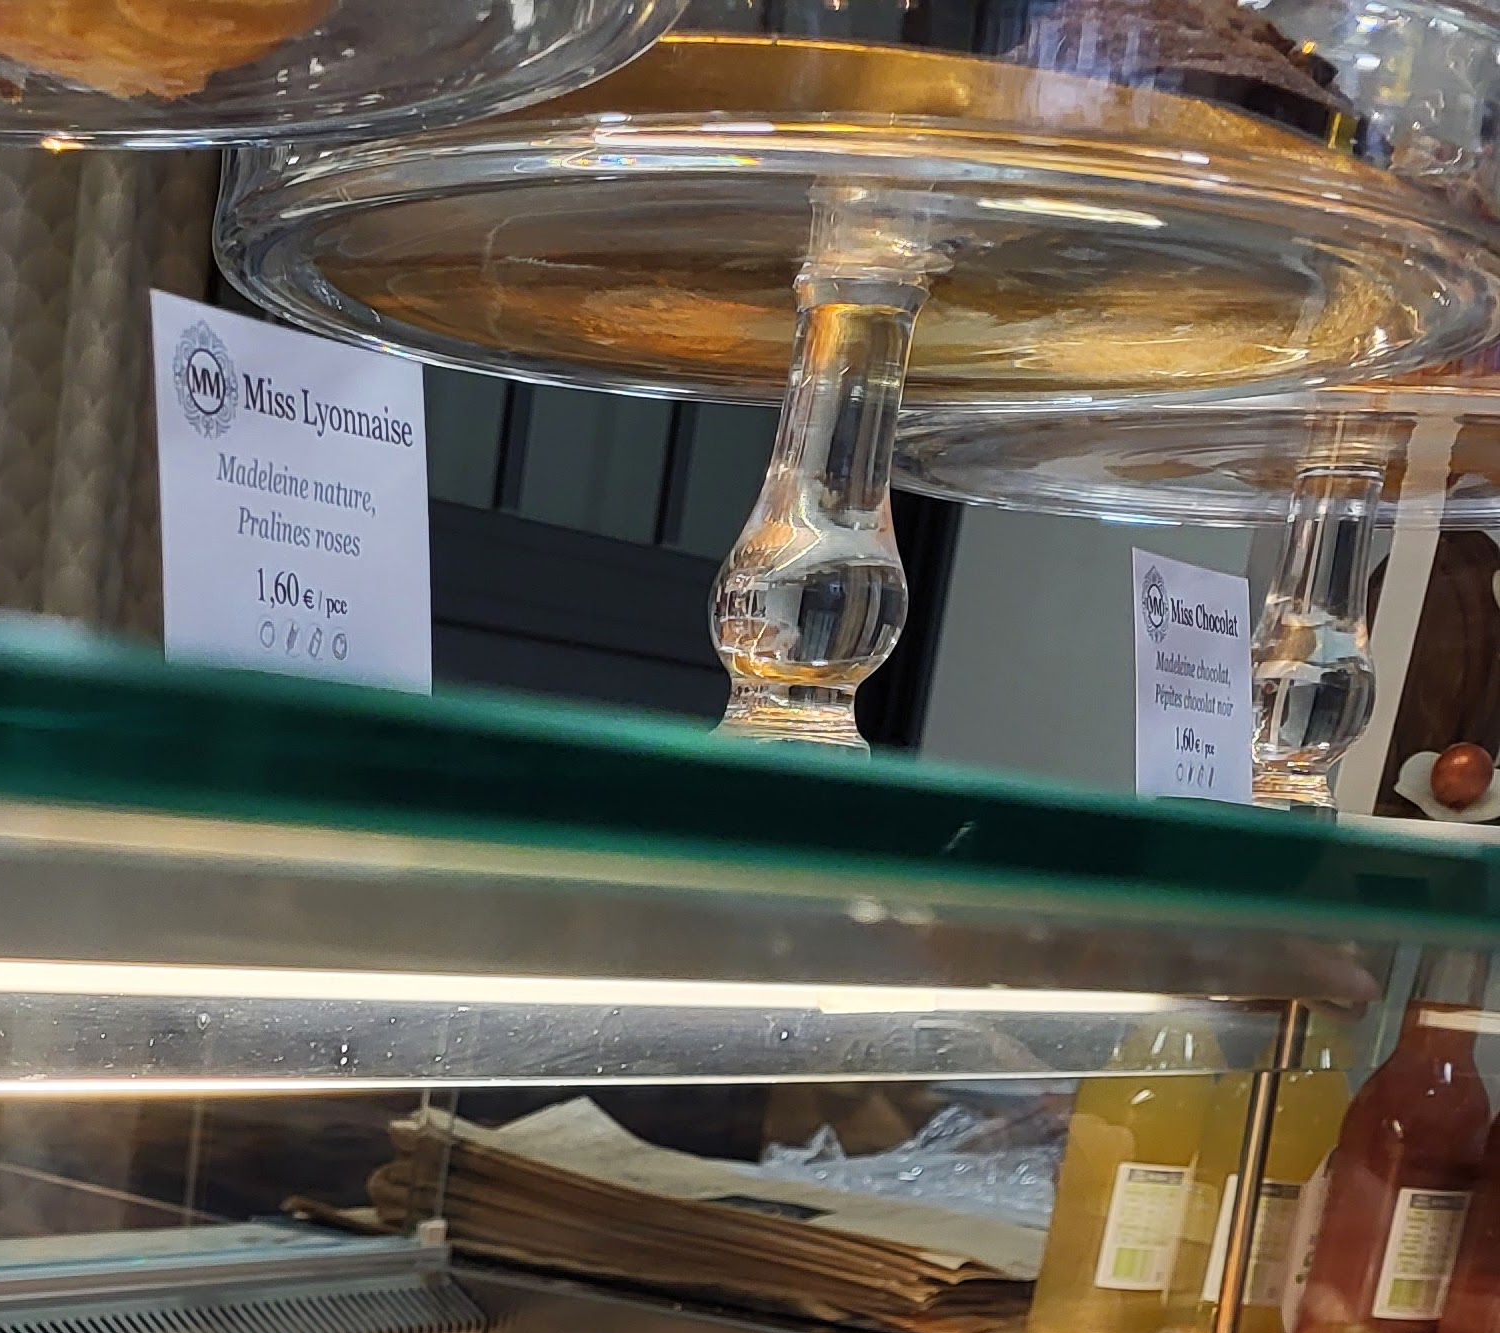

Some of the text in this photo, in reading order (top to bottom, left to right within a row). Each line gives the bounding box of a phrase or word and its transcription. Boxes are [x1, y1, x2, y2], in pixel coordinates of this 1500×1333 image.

[242, 373, 413, 448] Miss Lyonnaise
[216, 453, 377, 516] Madeleine nature,
[237, 506, 361, 557] Pralines roses
[258, 568, 299, 609] 1,60
[1170, 597, 1238, 637] Miss Chocolat
